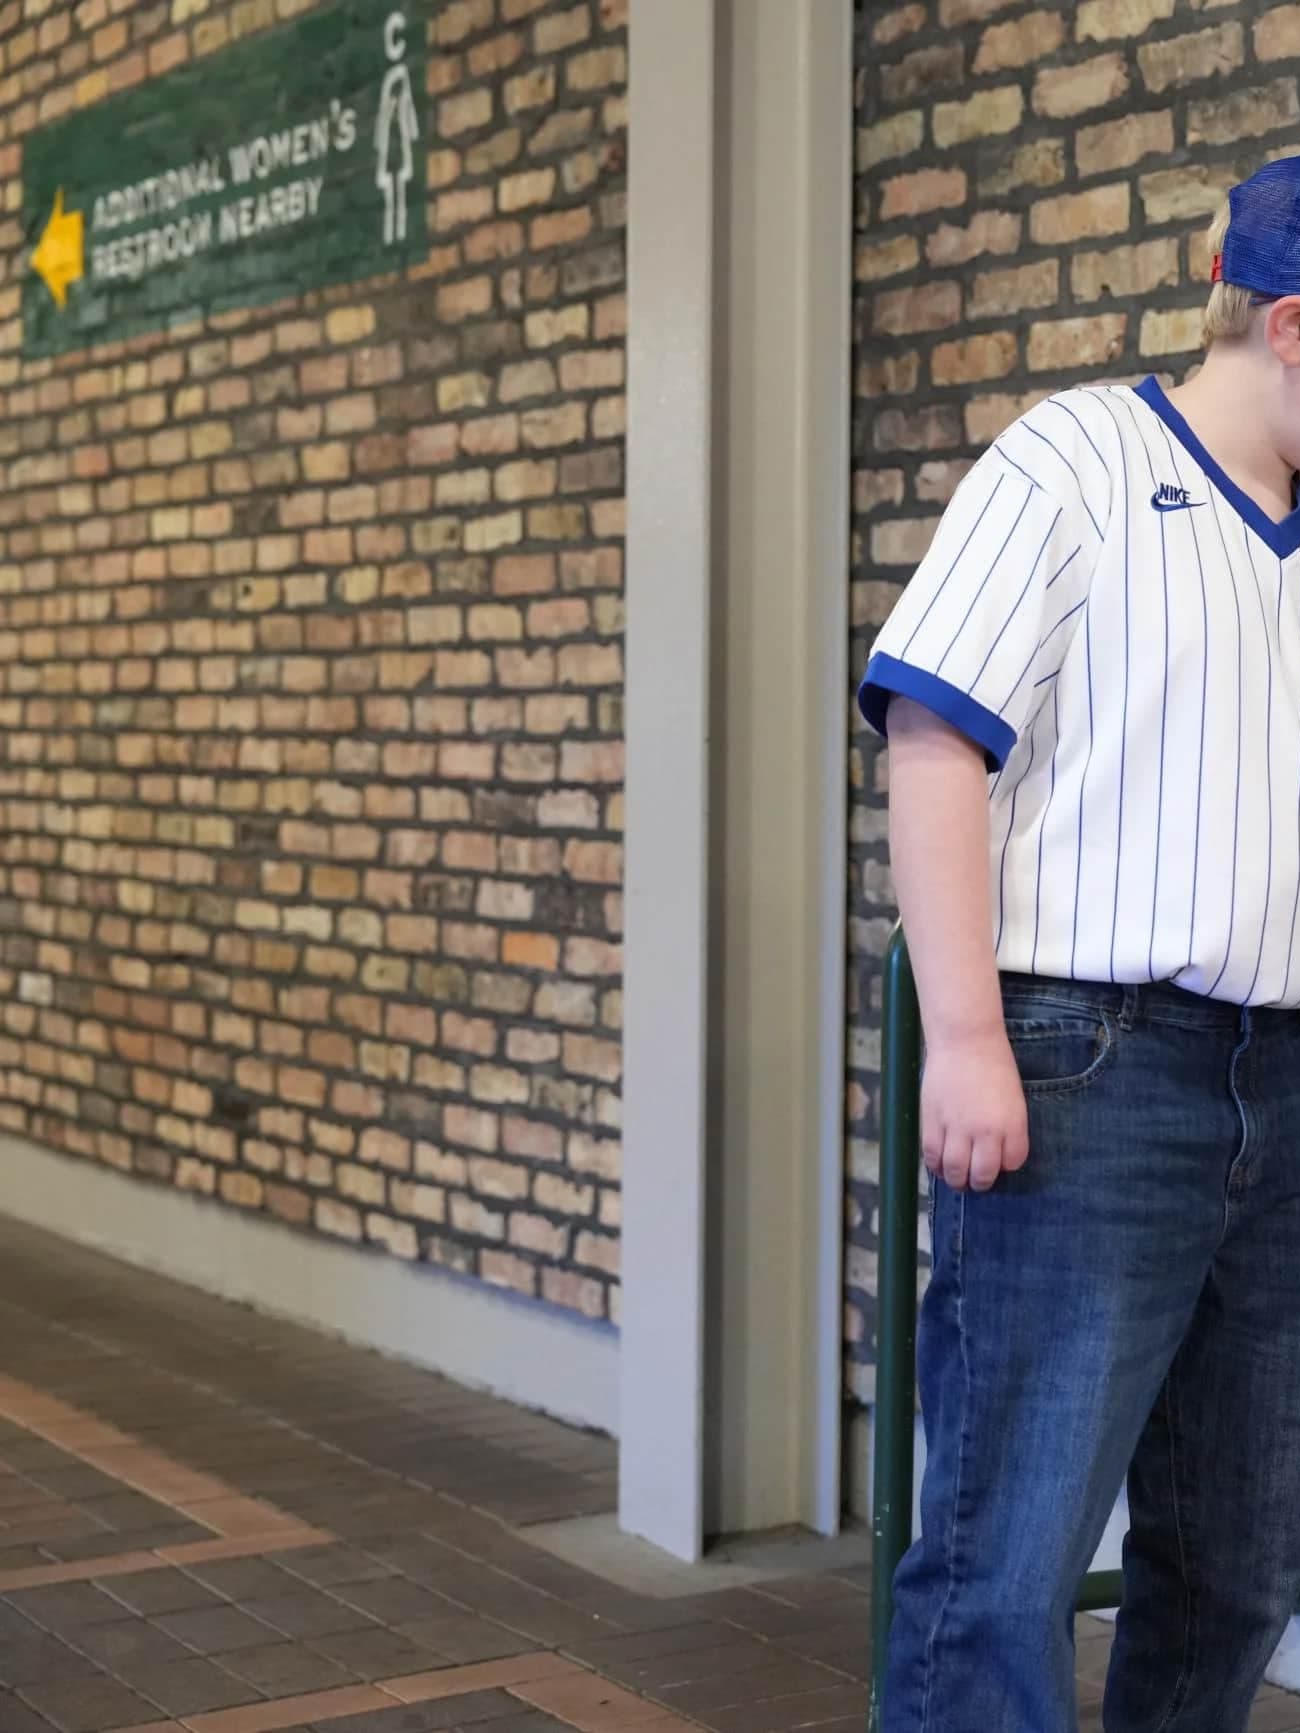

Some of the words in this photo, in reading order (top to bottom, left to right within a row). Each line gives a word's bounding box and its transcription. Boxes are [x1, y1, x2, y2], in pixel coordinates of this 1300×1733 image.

[92, 156, 225, 231] ADDITIONAL
[229, 98, 357, 184] WOMEN'S
[92, 211, 213, 283] RESTROOM
[218, 176, 324, 243] NEARBY
[1159, 482, 1191, 504] NIKE
